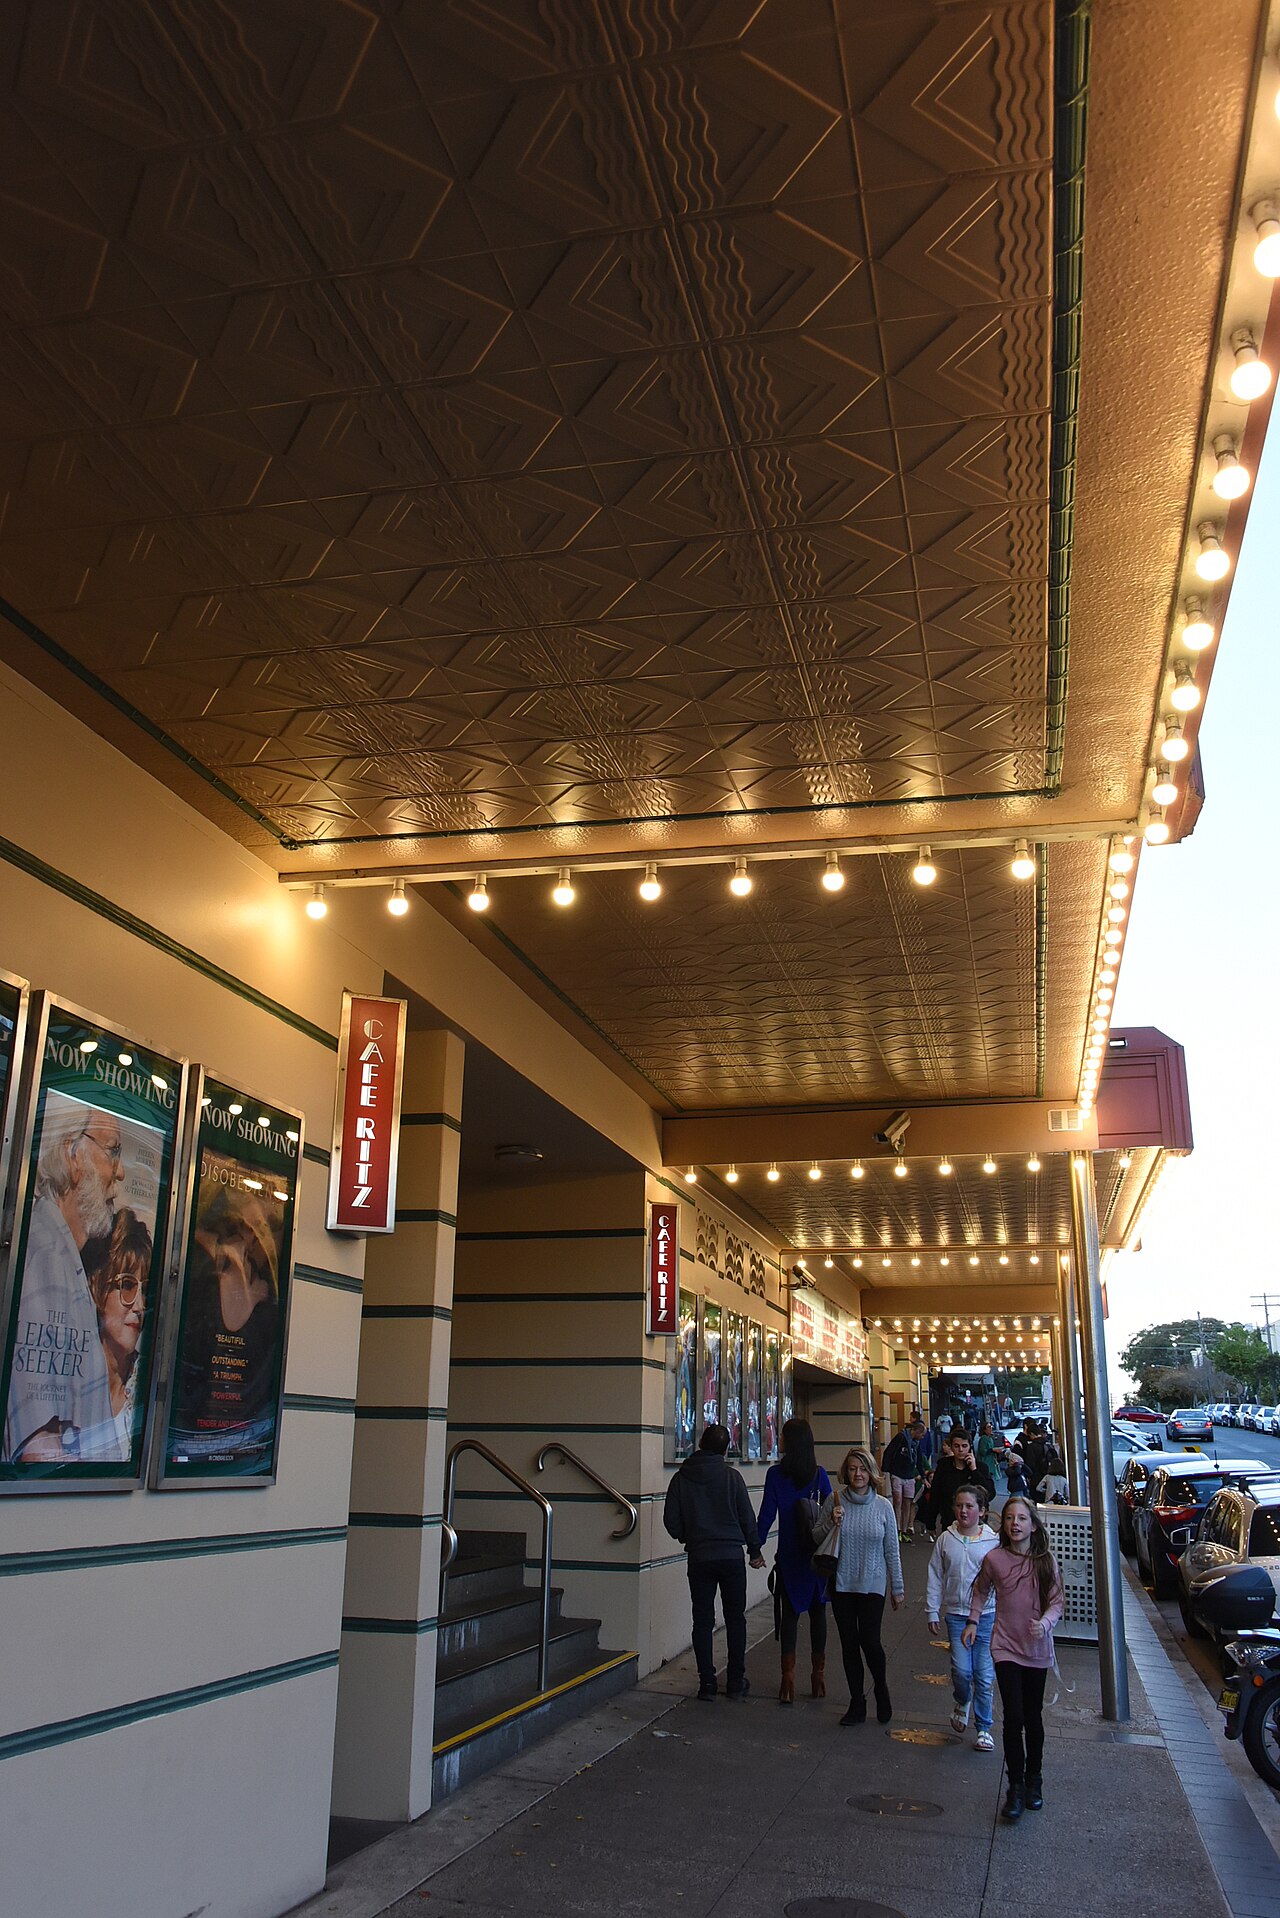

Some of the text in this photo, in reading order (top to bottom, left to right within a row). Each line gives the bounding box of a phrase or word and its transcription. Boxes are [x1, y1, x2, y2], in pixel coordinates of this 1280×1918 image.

[45, 1035, 176, 1109] NOW SHOWING
[201, 1104, 297, 1158] NOW SHOWING
[351, 1019, 385, 1209] CAFE RITZ
[656, 1214, 671, 1323] CAFE RITZ
[15, 1320, 91, 1353] LEISURE
[46, 1309, 67, 1325] THE
[15, 1346, 84, 1378] SEEKER
